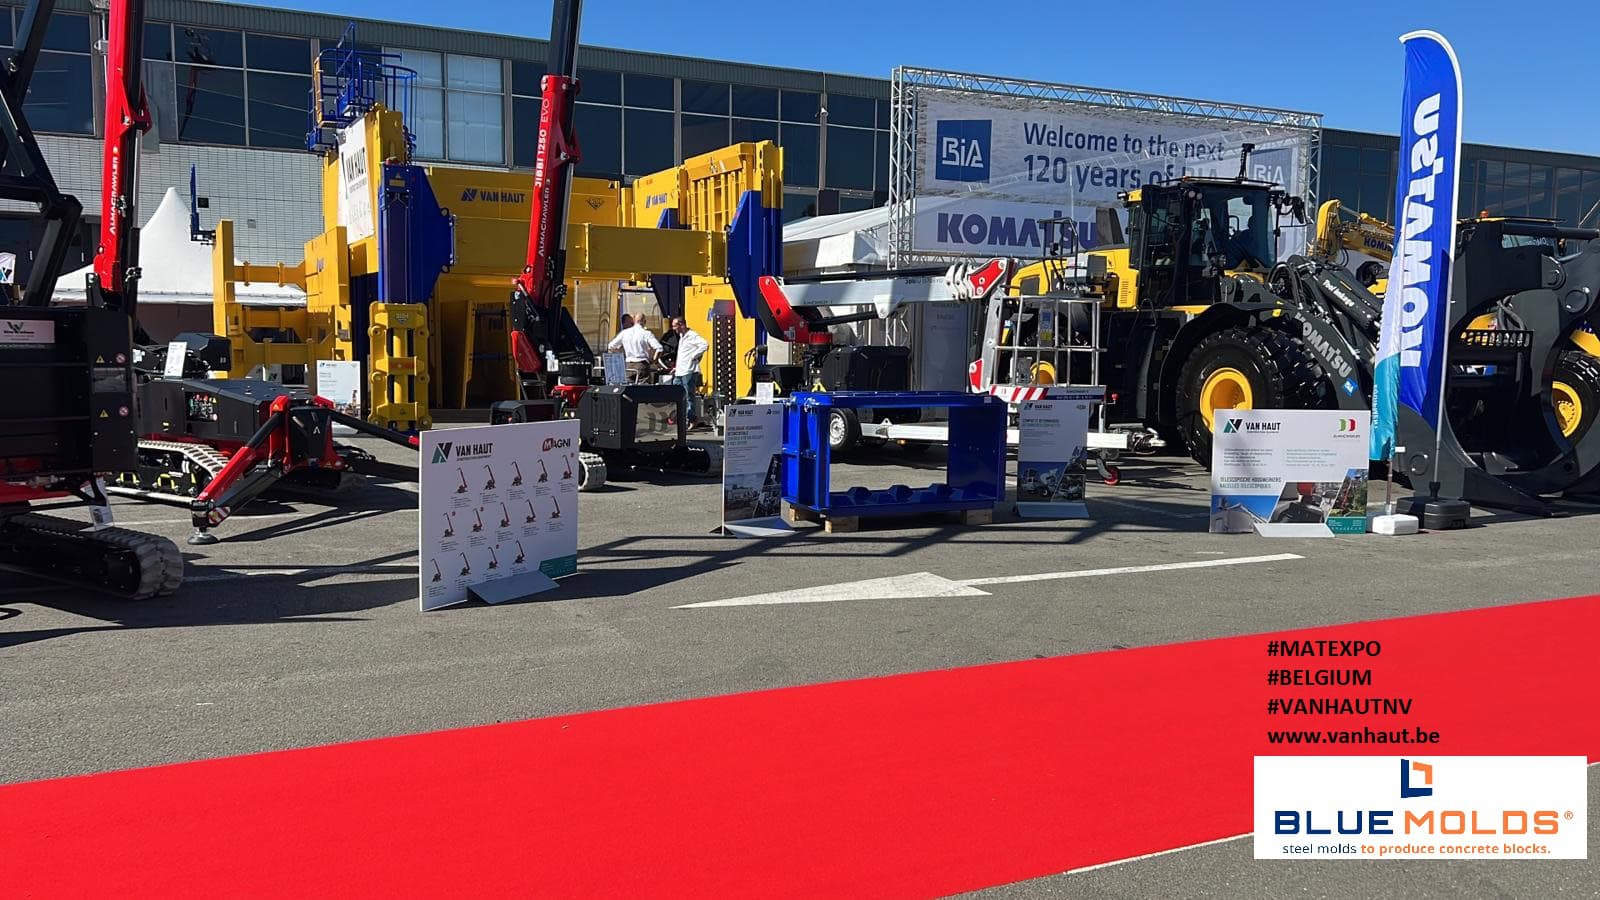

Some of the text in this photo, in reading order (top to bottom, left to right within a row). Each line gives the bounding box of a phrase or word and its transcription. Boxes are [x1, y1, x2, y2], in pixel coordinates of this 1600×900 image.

[535, 157, 545, 189] JIBBI
[541, 98, 550, 123] EVO
[1023, 122, 1224, 162] Welcome to the next
[1023, 155, 1175, 193] 120 years of
[480, 190, 525, 204] VAN HAUT
[1245, 422, 1281, 431] VAN HAUT
[456, 443, 493, 457] VAN HAUT
[543, 437, 571, 452] MAGNI
